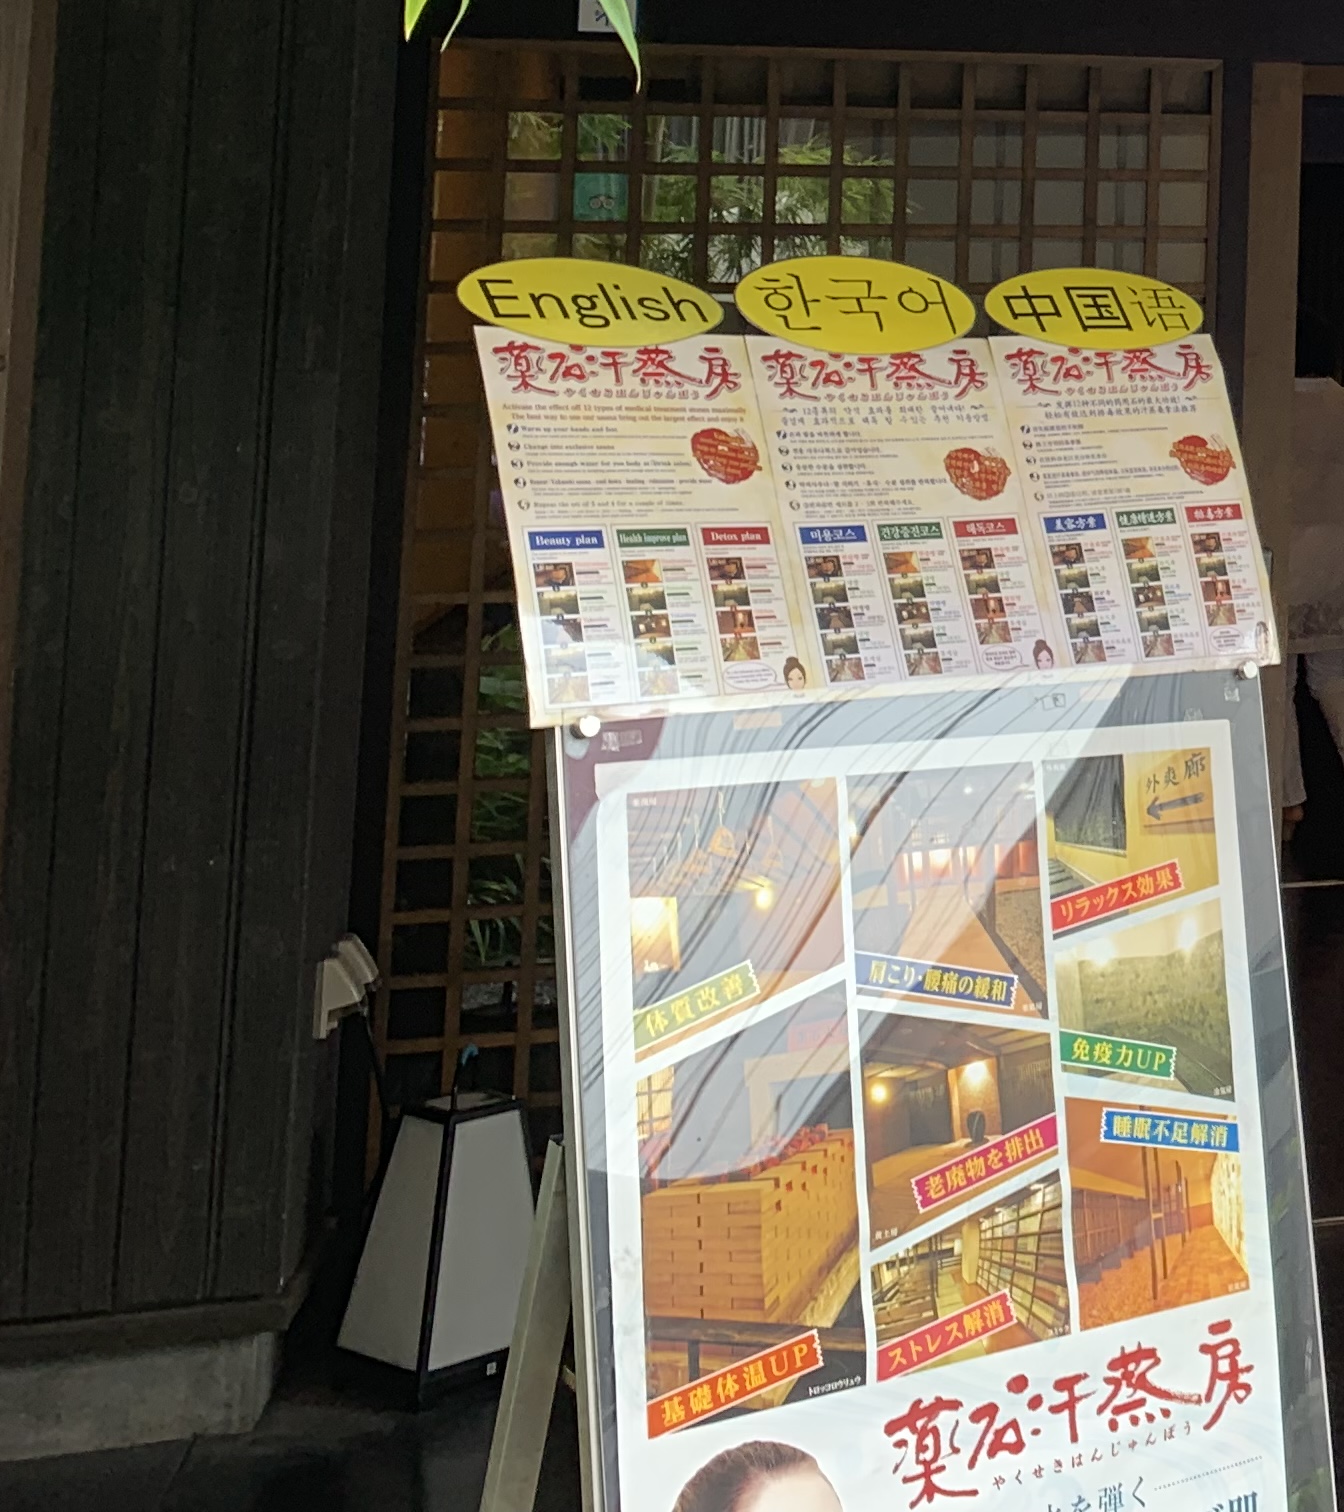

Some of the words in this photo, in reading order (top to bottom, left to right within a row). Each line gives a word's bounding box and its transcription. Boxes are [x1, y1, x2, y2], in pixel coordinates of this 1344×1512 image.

[477, 279, 709, 328] English
[753, 273, 957, 334] 한국어
[1003, 285, 1191, 332] 中国语
[1060, 870, 1175, 921] リラックス効果
[645, 974, 744, 1038] 体質改善
[869, 963, 1008, 1002] 肩こり・腰痛の緩和
[1071, 1037, 1167, 1072] 免疫力UP
[1112, 1114, 1228, 1148] 睡眠不足解消
[925, 1128, 1045, 1201] 老廃物を排出
[887, 1299, 1006, 1372] ストレス解消
[661, 1344, 811, 1427] 基礎体温UP
[883, 1319, 1256, 1510] 薬石汗蒸房
[991, 1420, 1192, 1490] やくせきはんじゅんぼう
